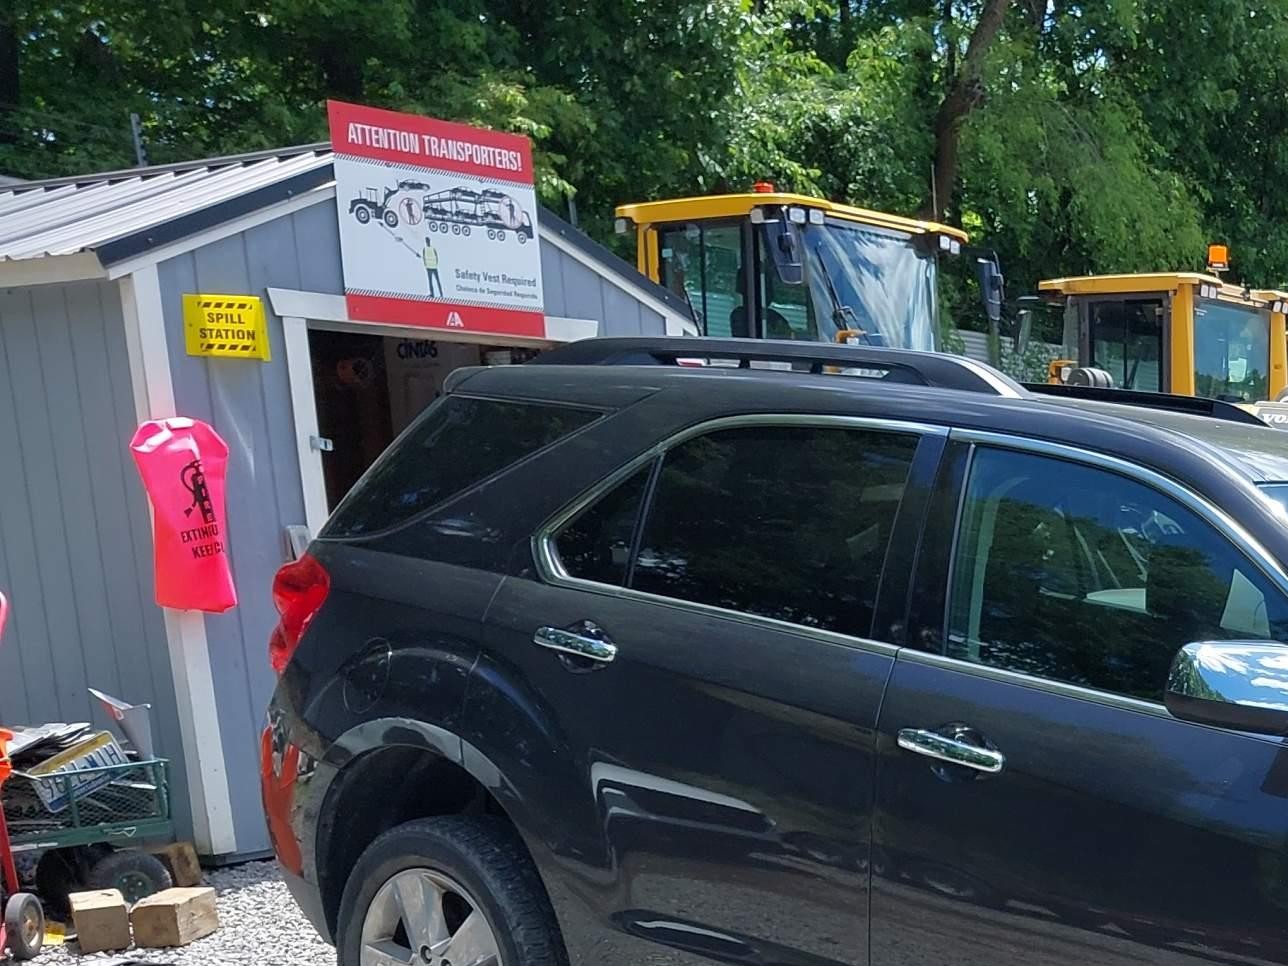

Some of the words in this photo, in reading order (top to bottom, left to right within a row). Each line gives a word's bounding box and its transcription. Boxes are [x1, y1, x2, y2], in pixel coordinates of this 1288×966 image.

[348, 123, 419, 154] ATTENTION
[422, 135, 522, 171] TRANSPORTERS!
[455, 268, 480, 283] Safety
[482, 271, 499, 283] Vest
[501, 273, 537, 287] Required
[207, 312, 245, 324] SPILL
[199, 328, 256, 340] STATION
